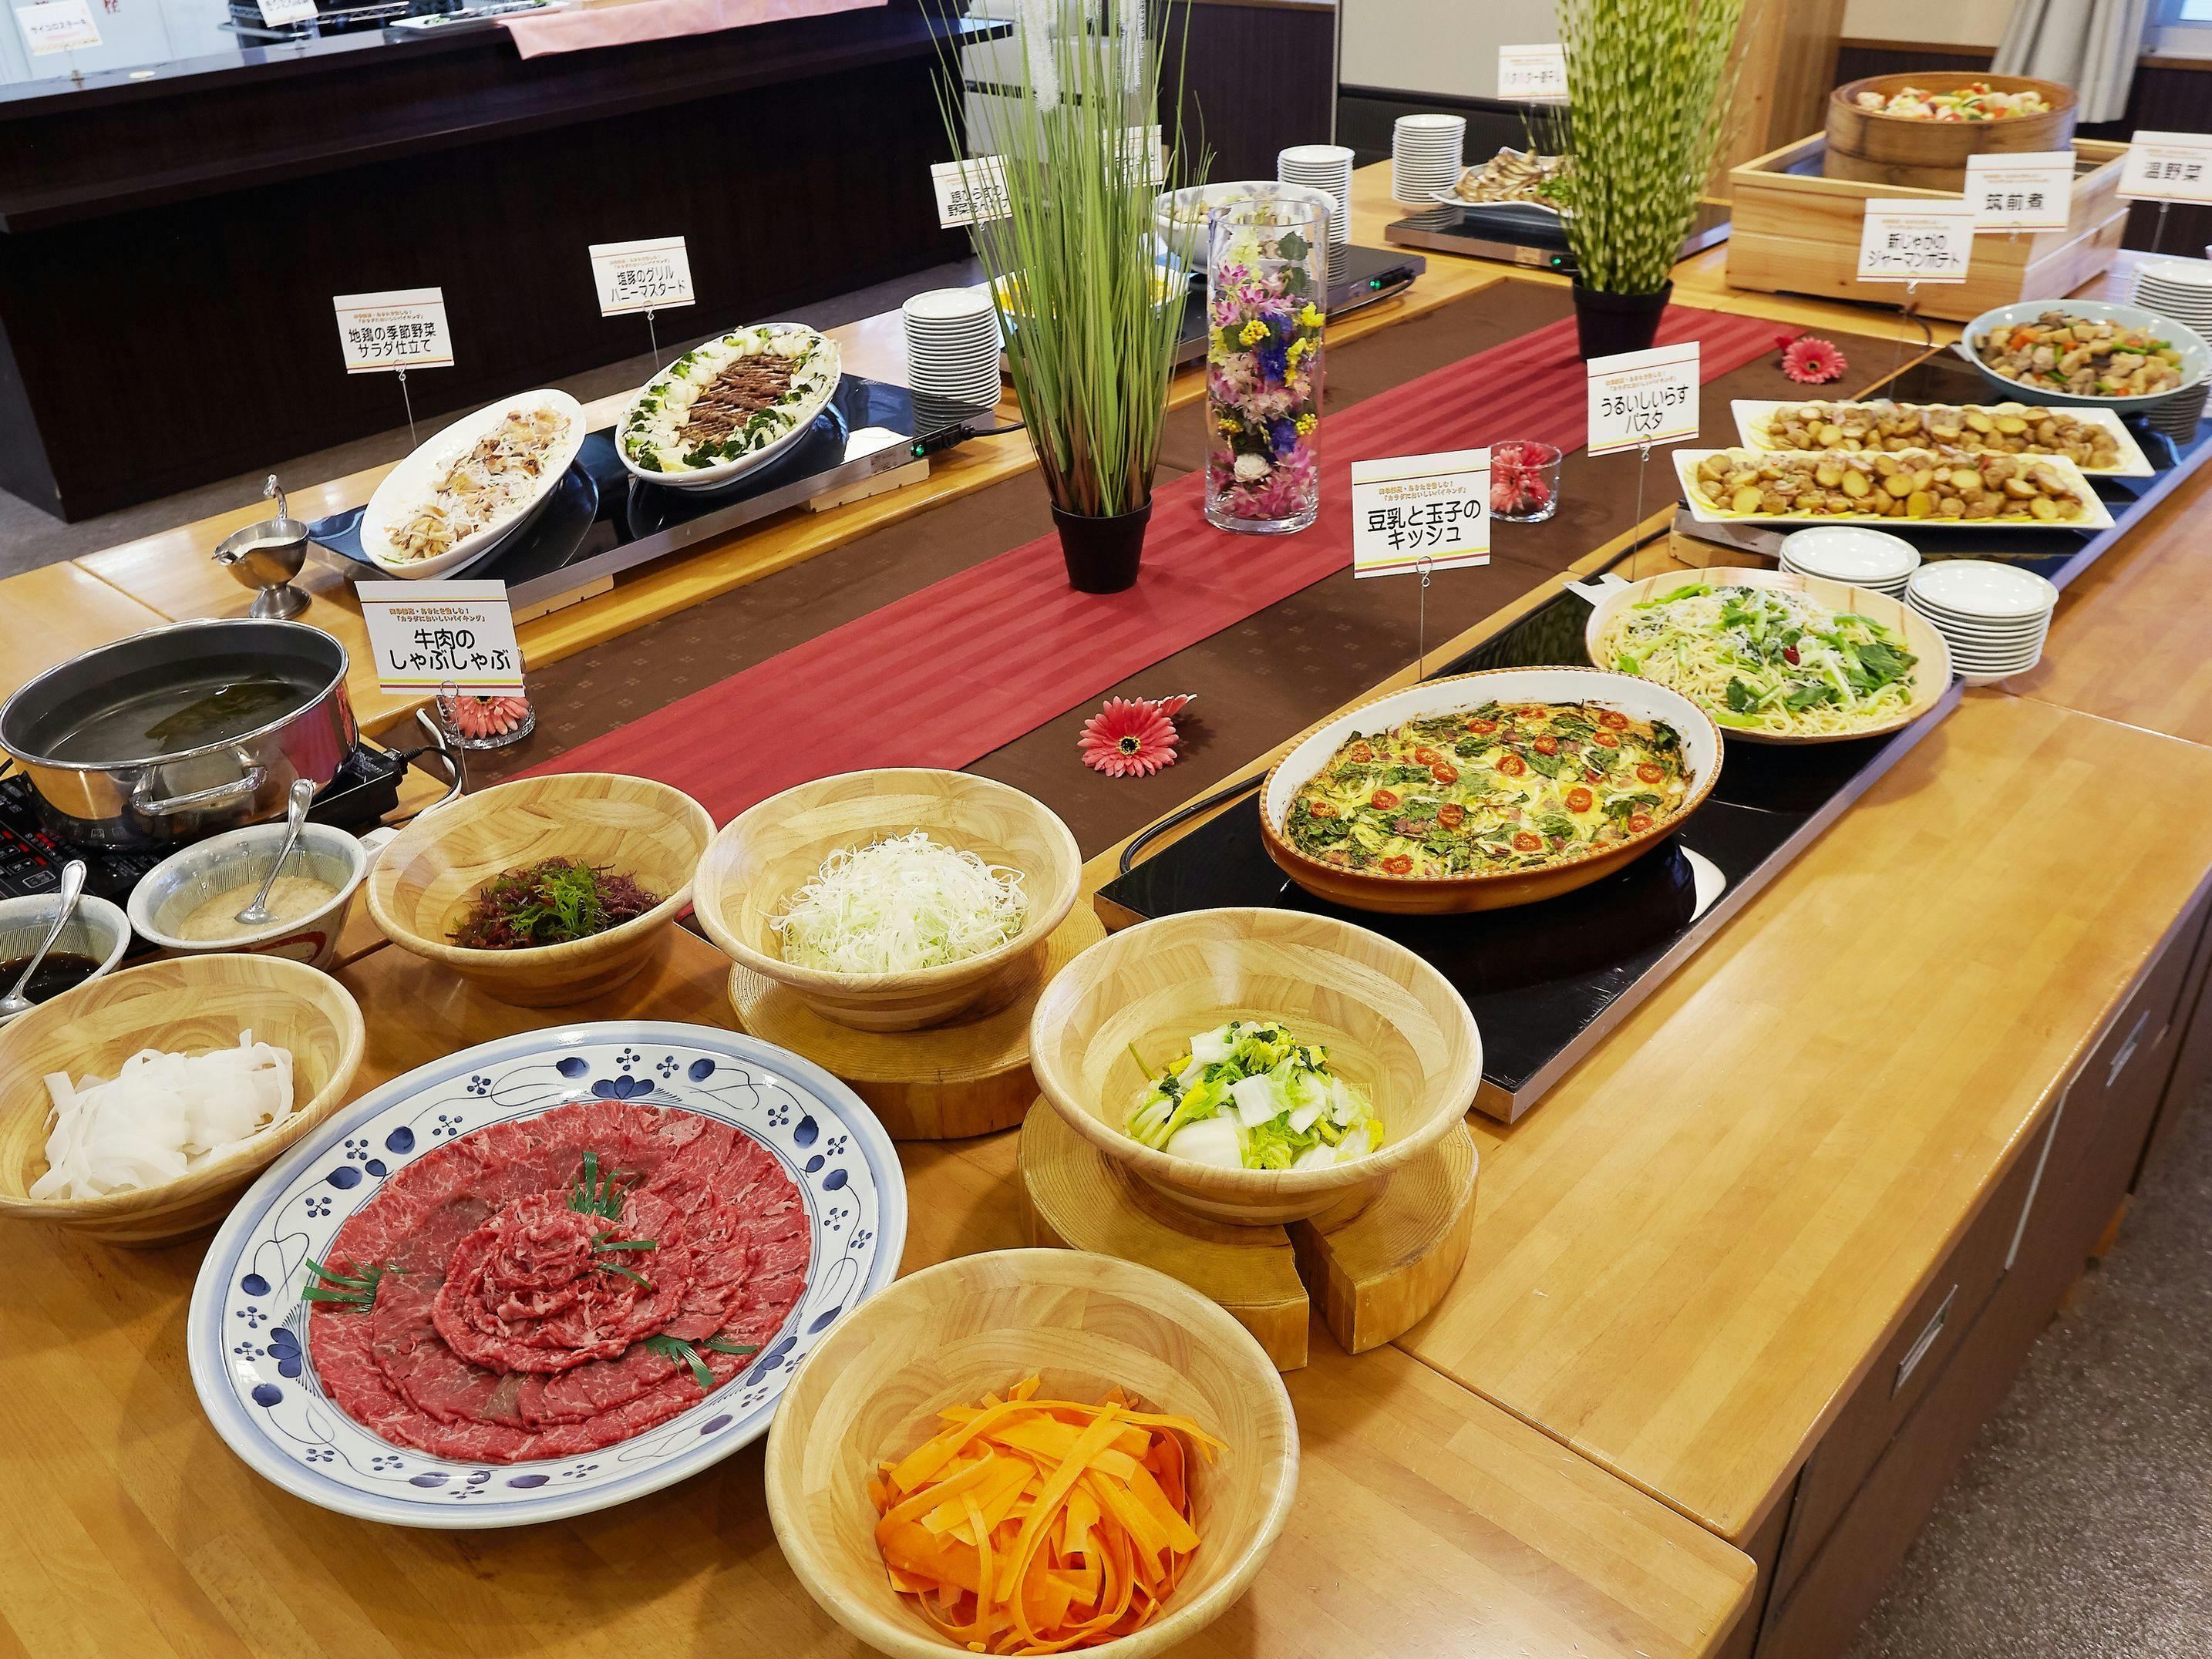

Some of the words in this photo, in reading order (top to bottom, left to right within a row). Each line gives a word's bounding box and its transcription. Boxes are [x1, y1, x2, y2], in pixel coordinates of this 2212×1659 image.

[2145, 161, 2202, 181] 温野菜
[1985, 193, 2044, 210] 筑前煮
[1888, 234, 1948, 250] 新じゃがの
[1868, 251, 1960, 268] ジャーマンポテト
[617, 266, 674, 286] 塩豚のグリル
[611, 279, 685, 301] ハニーマスタード
[348, 322, 436, 344] 地鶏の季節野菜
[359, 339, 431, 358] サラダ仕立て
[1601, 385, 1688, 417] うるいしいらす
[1626, 409, 1663, 433] パスタ
[1367, 500, 1481, 532] 豆乳と玉子の
[1388, 525, 1461, 550] キッシュ
[414, 628, 475, 650] 牛肉の
[389, 649, 510, 671] しゃぶしゃぶ
